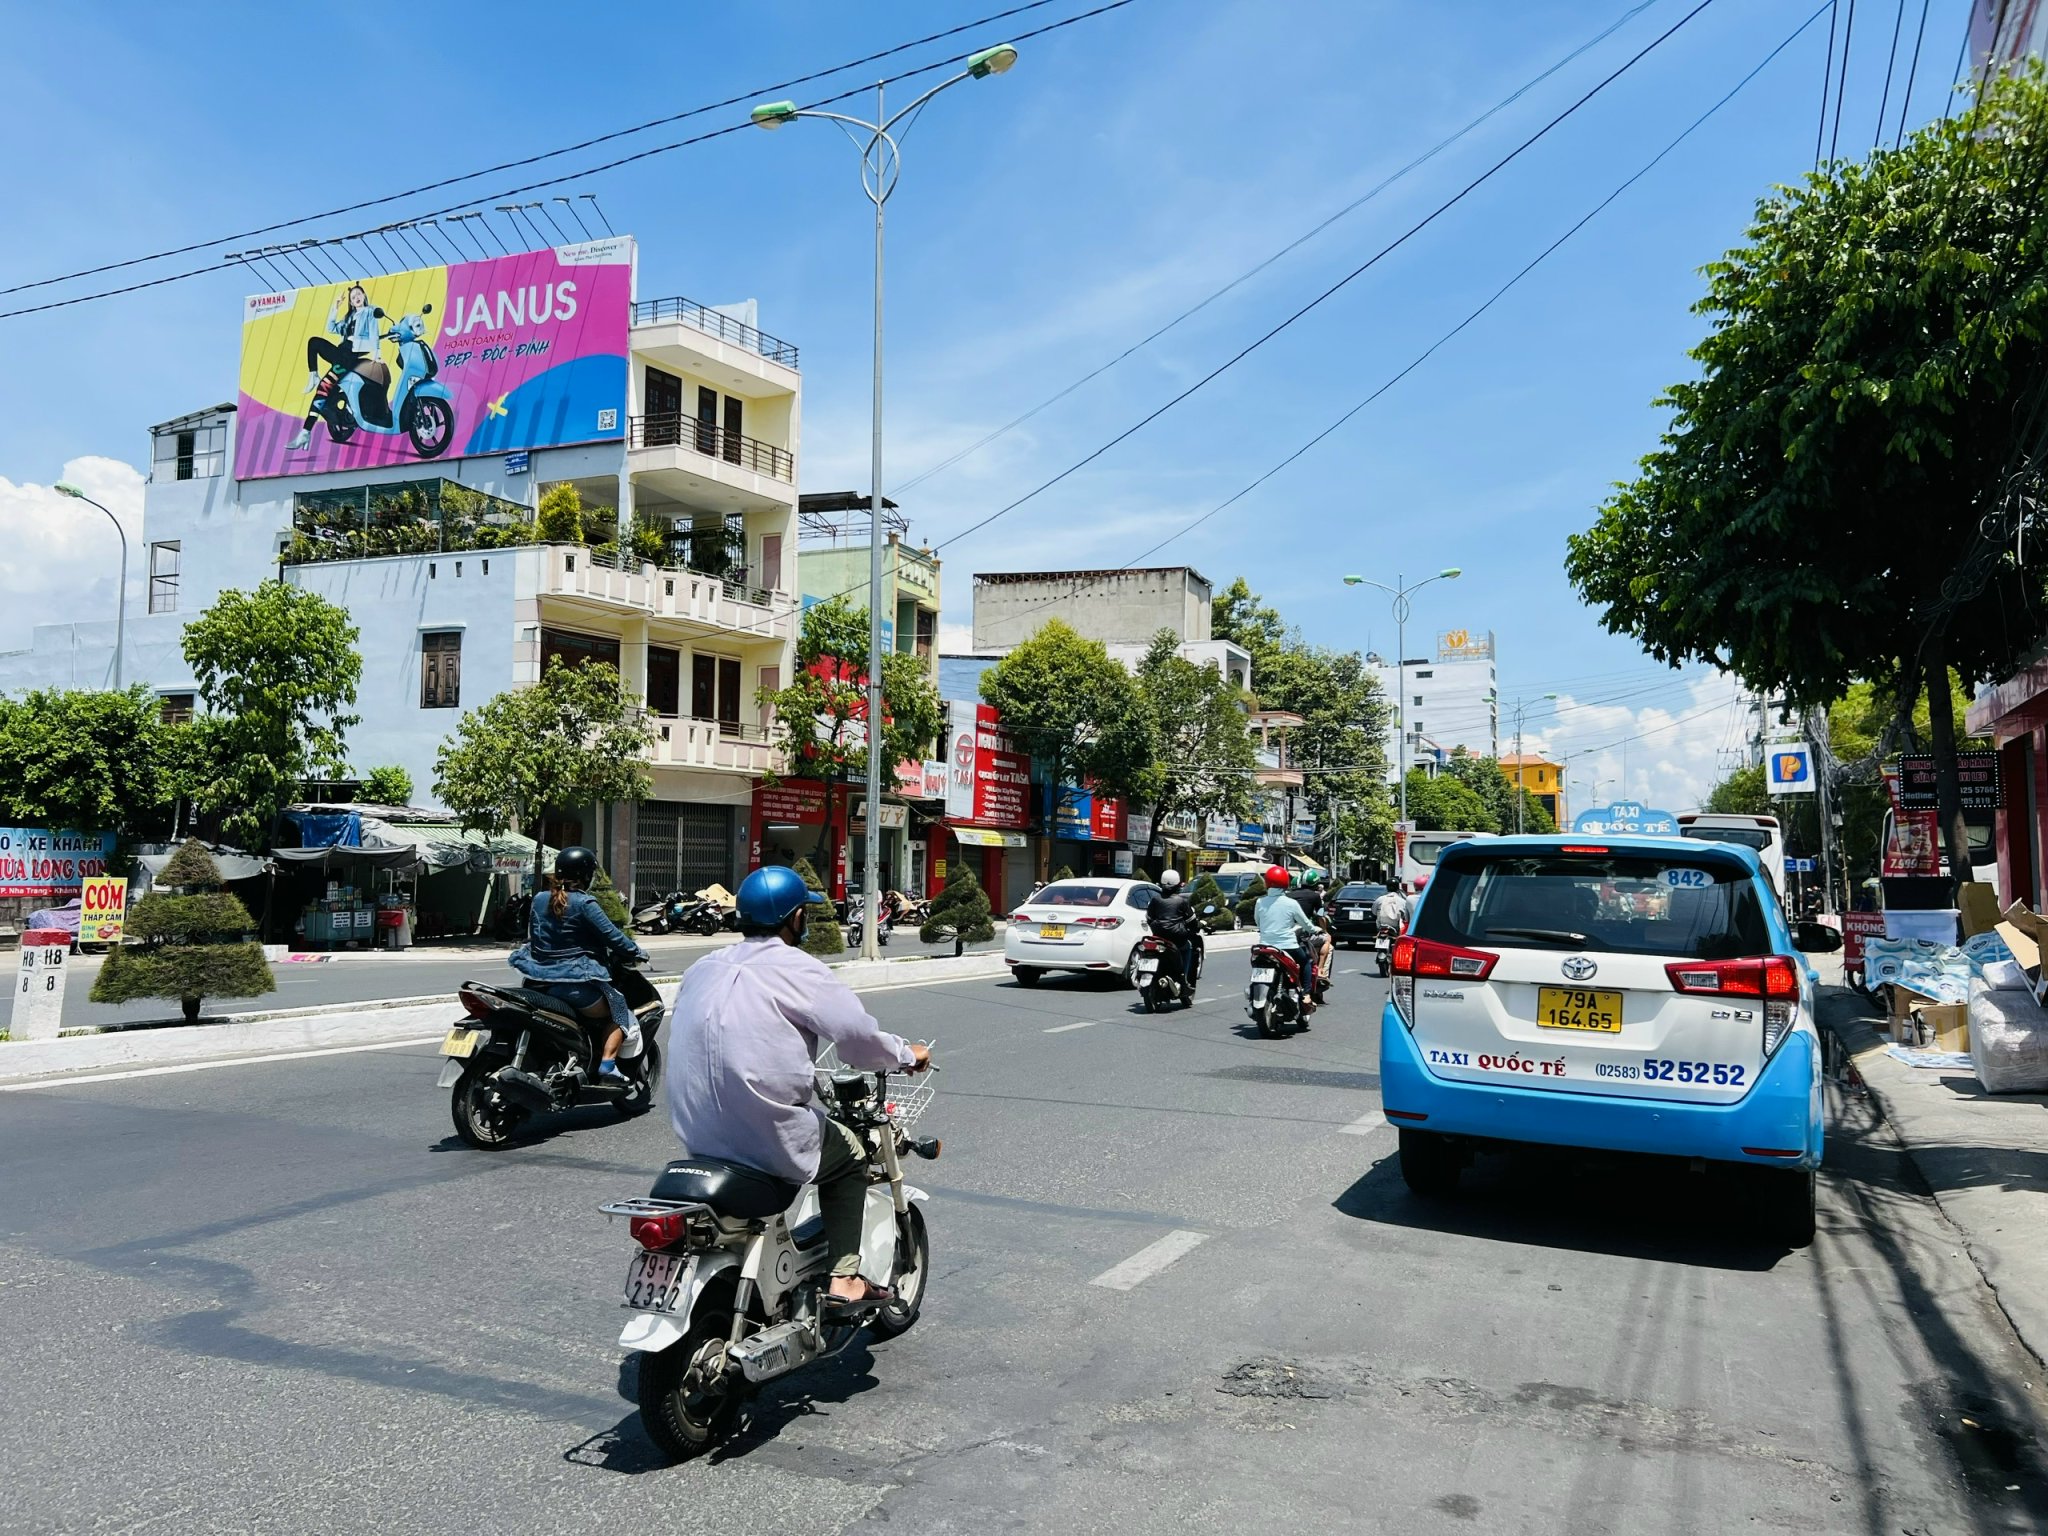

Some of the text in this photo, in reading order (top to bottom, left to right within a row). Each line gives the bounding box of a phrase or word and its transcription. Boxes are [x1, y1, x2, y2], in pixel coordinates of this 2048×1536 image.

[257, 295, 286, 306] YAMAHA
[444, 280, 576, 336] JANUS
[445, 351, 473, 368] ĐẸP
[481, 344, 508, 364] ĐỘC
[1904, 761, 1931, 770] TRUNG
[954, 769, 974, 785] TASA
[1613, 806, 1639, 818] TAXI
[1644, 819, 1671, 832] TẾ
[29, 837, 47, 851] XE
[753, 841, 760, 855] 5
[839, 845, 846, 858] 5
[32, 859, 74, 880] LONG
[1668, 870, 1704, 886] 842
[85, 880, 124, 910] CƠM
[1846, 921, 1885, 933] KHÔNG
[23, 951, 34, 967] H8
[45, 949, 62, 965] H8
[23, 977, 28, 992] 8
[47, 975, 54, 991] 8
[1562, 991, 1598, 1009] 79A
[1549, 1009, 1612, 1029] 164.65
[1430, 1051, 1745, 1086] TAXI QUỐC TẾ (02583) 525252
[668, 1167, 712, 1178] HONDA
[631, 1280, 680, 1311] 2332
